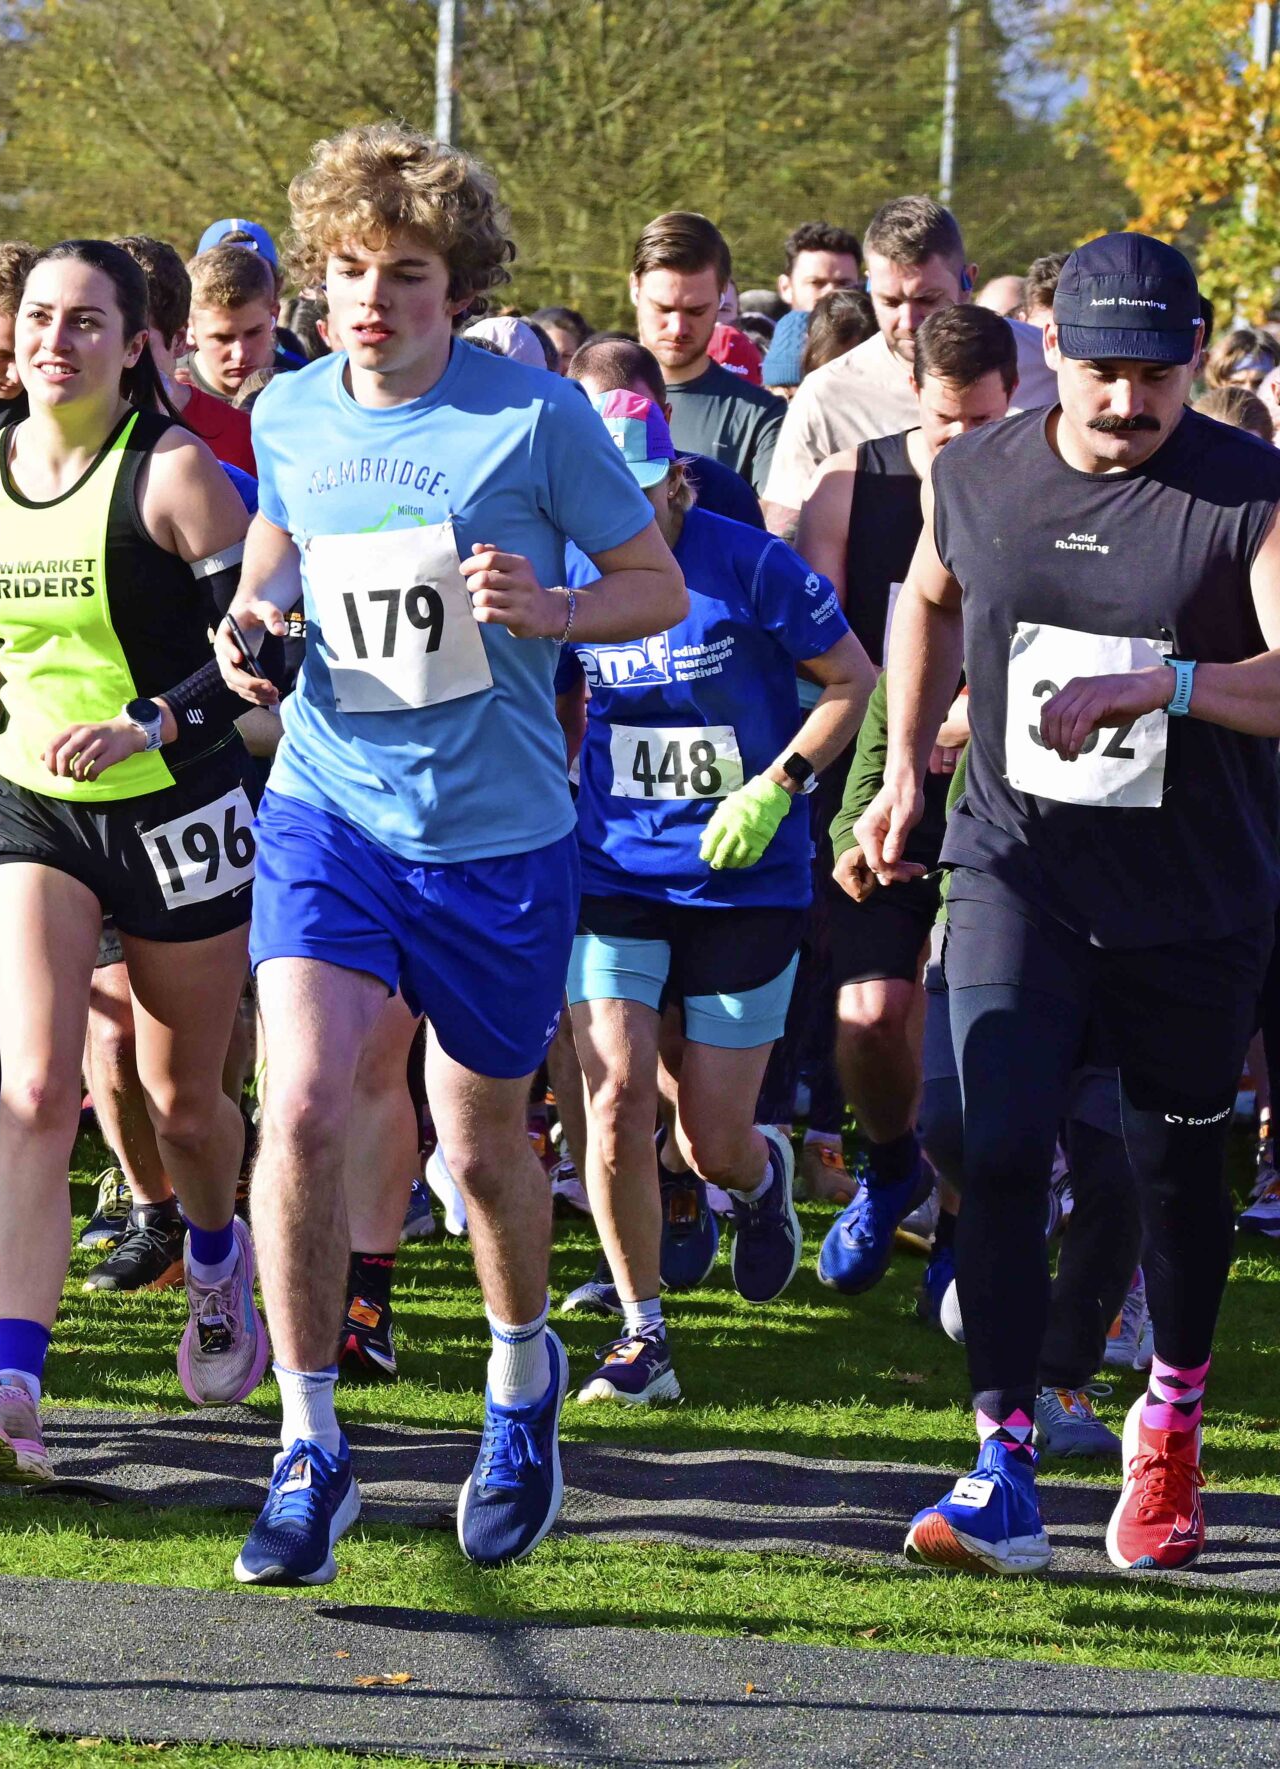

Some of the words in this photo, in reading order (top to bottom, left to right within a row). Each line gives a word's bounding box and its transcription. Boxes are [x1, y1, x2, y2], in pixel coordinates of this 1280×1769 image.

[1090, 298, 1115, 307] Acid
[1118, 297, 1167, 311] Running
[311, 457, 447, 497] CAMBRIDGE
[397, 503, 424, 516] Milton
[1055, 539, 1110, 555] Running
[1067, 532, 1097, 543] Acid
[344, 584, 445, 659] 179
[672, 635, 735, 658] edinburgh
[575, 632, 670, 687] emf
[673, 648, 733, 670] marathon
[632, 740, 722, 797] 448
[153, 805, 256, 894] 196
